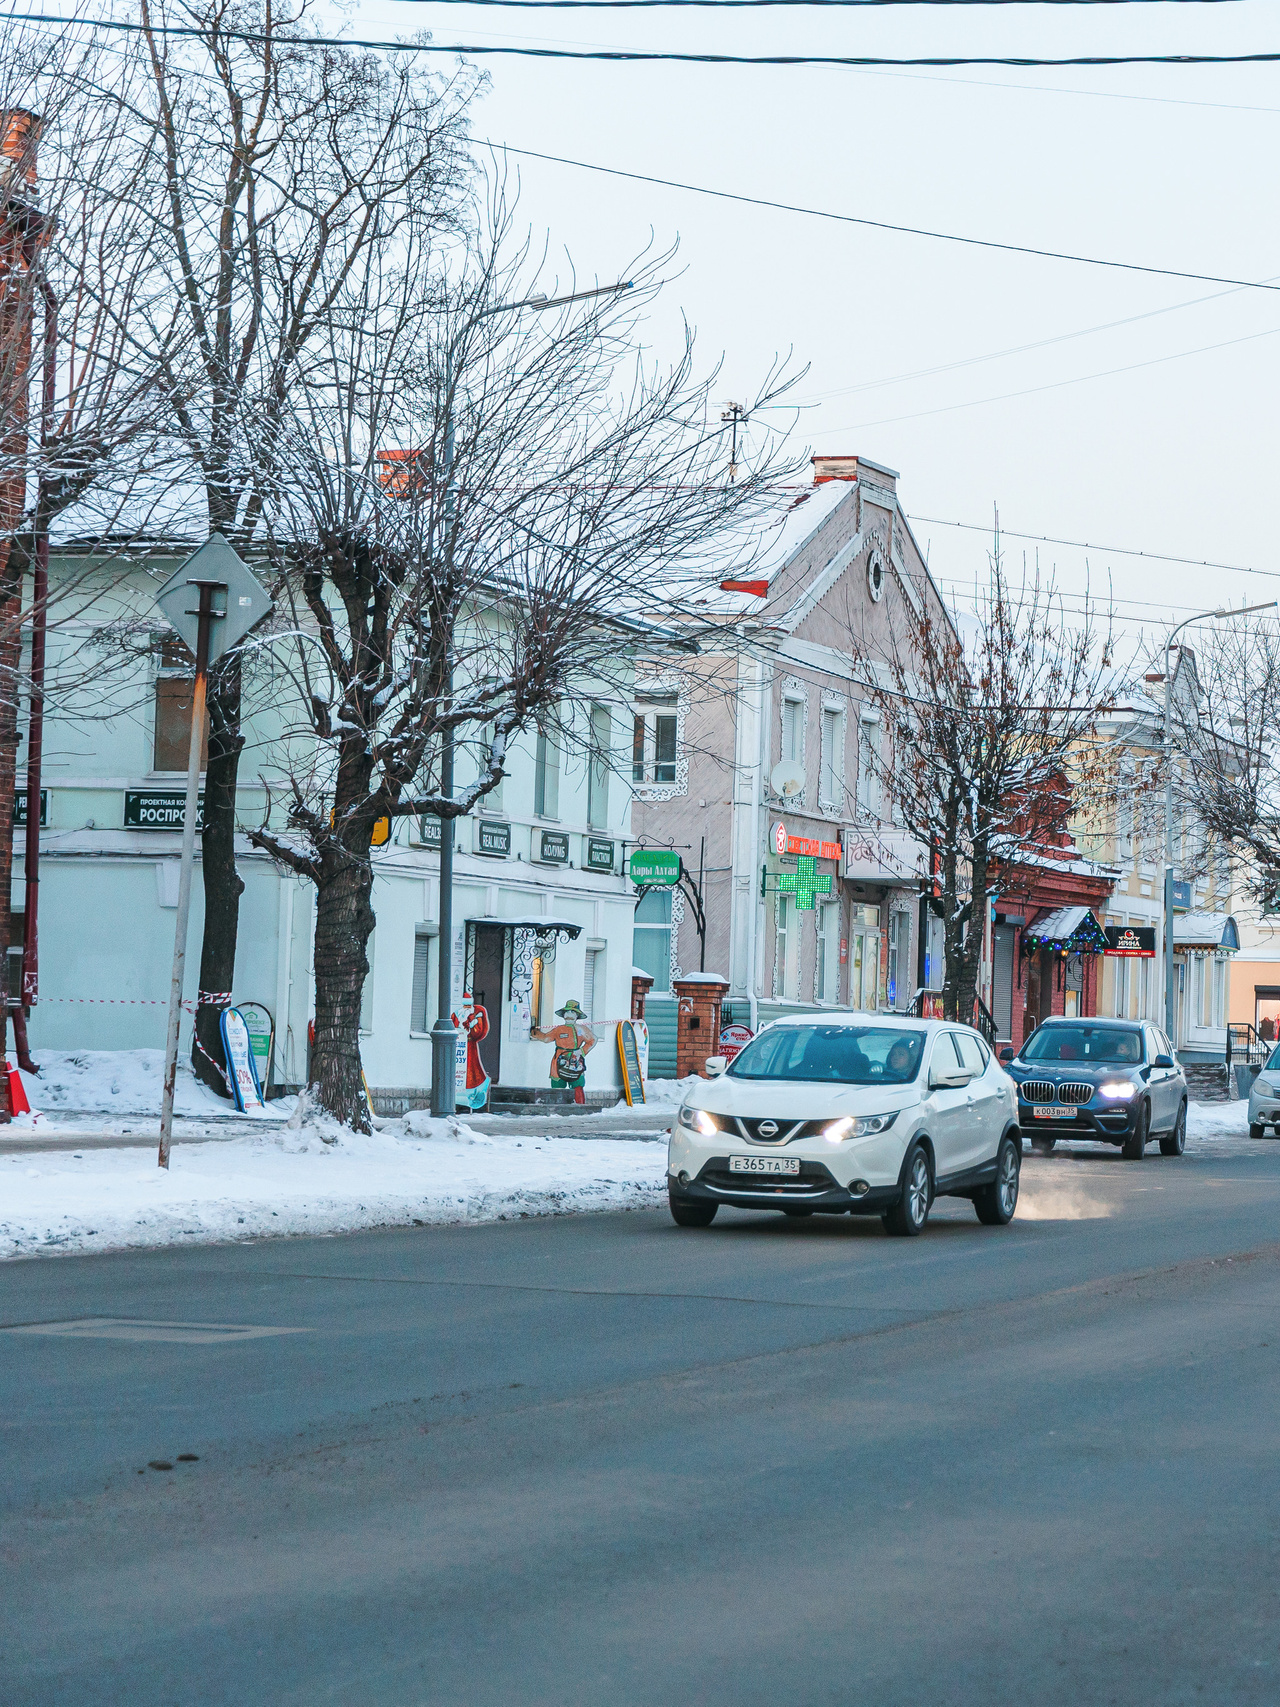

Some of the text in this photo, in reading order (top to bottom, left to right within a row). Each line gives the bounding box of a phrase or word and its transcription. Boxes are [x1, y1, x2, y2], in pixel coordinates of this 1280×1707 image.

[482, 834, 494, 847] REAL
[631, 865, 678, 877] Дары Алтая
[1036, 1107, 1065, 1116] К003ВН
[734, 1158, 796, 1171] Е365ТА 35
